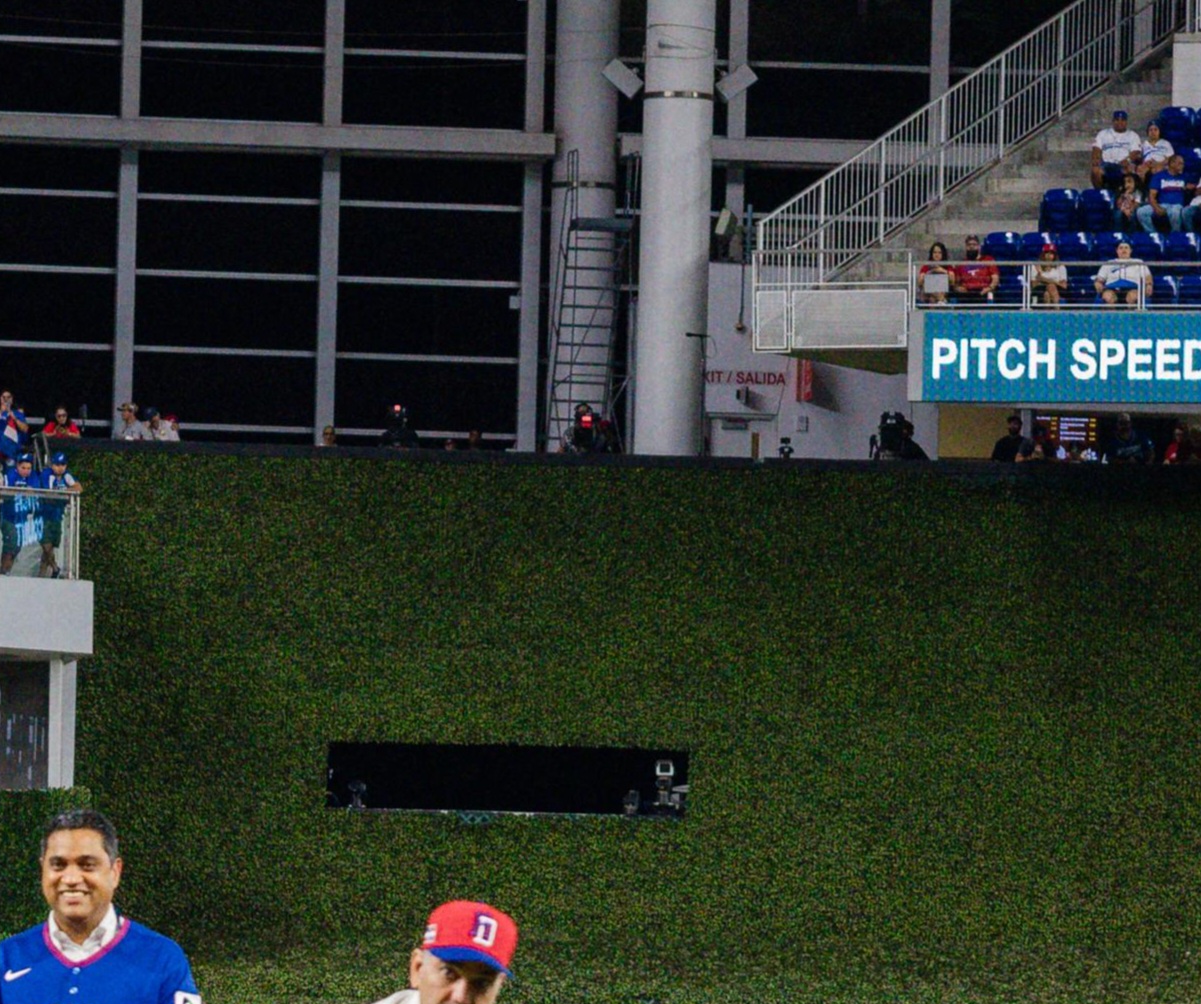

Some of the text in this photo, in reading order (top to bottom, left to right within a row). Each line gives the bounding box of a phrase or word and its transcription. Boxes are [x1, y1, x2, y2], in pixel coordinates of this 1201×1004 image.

[931, 338, 1201, 380] PITCH SPEED
[736, 371, 786, 386] SALIDA
